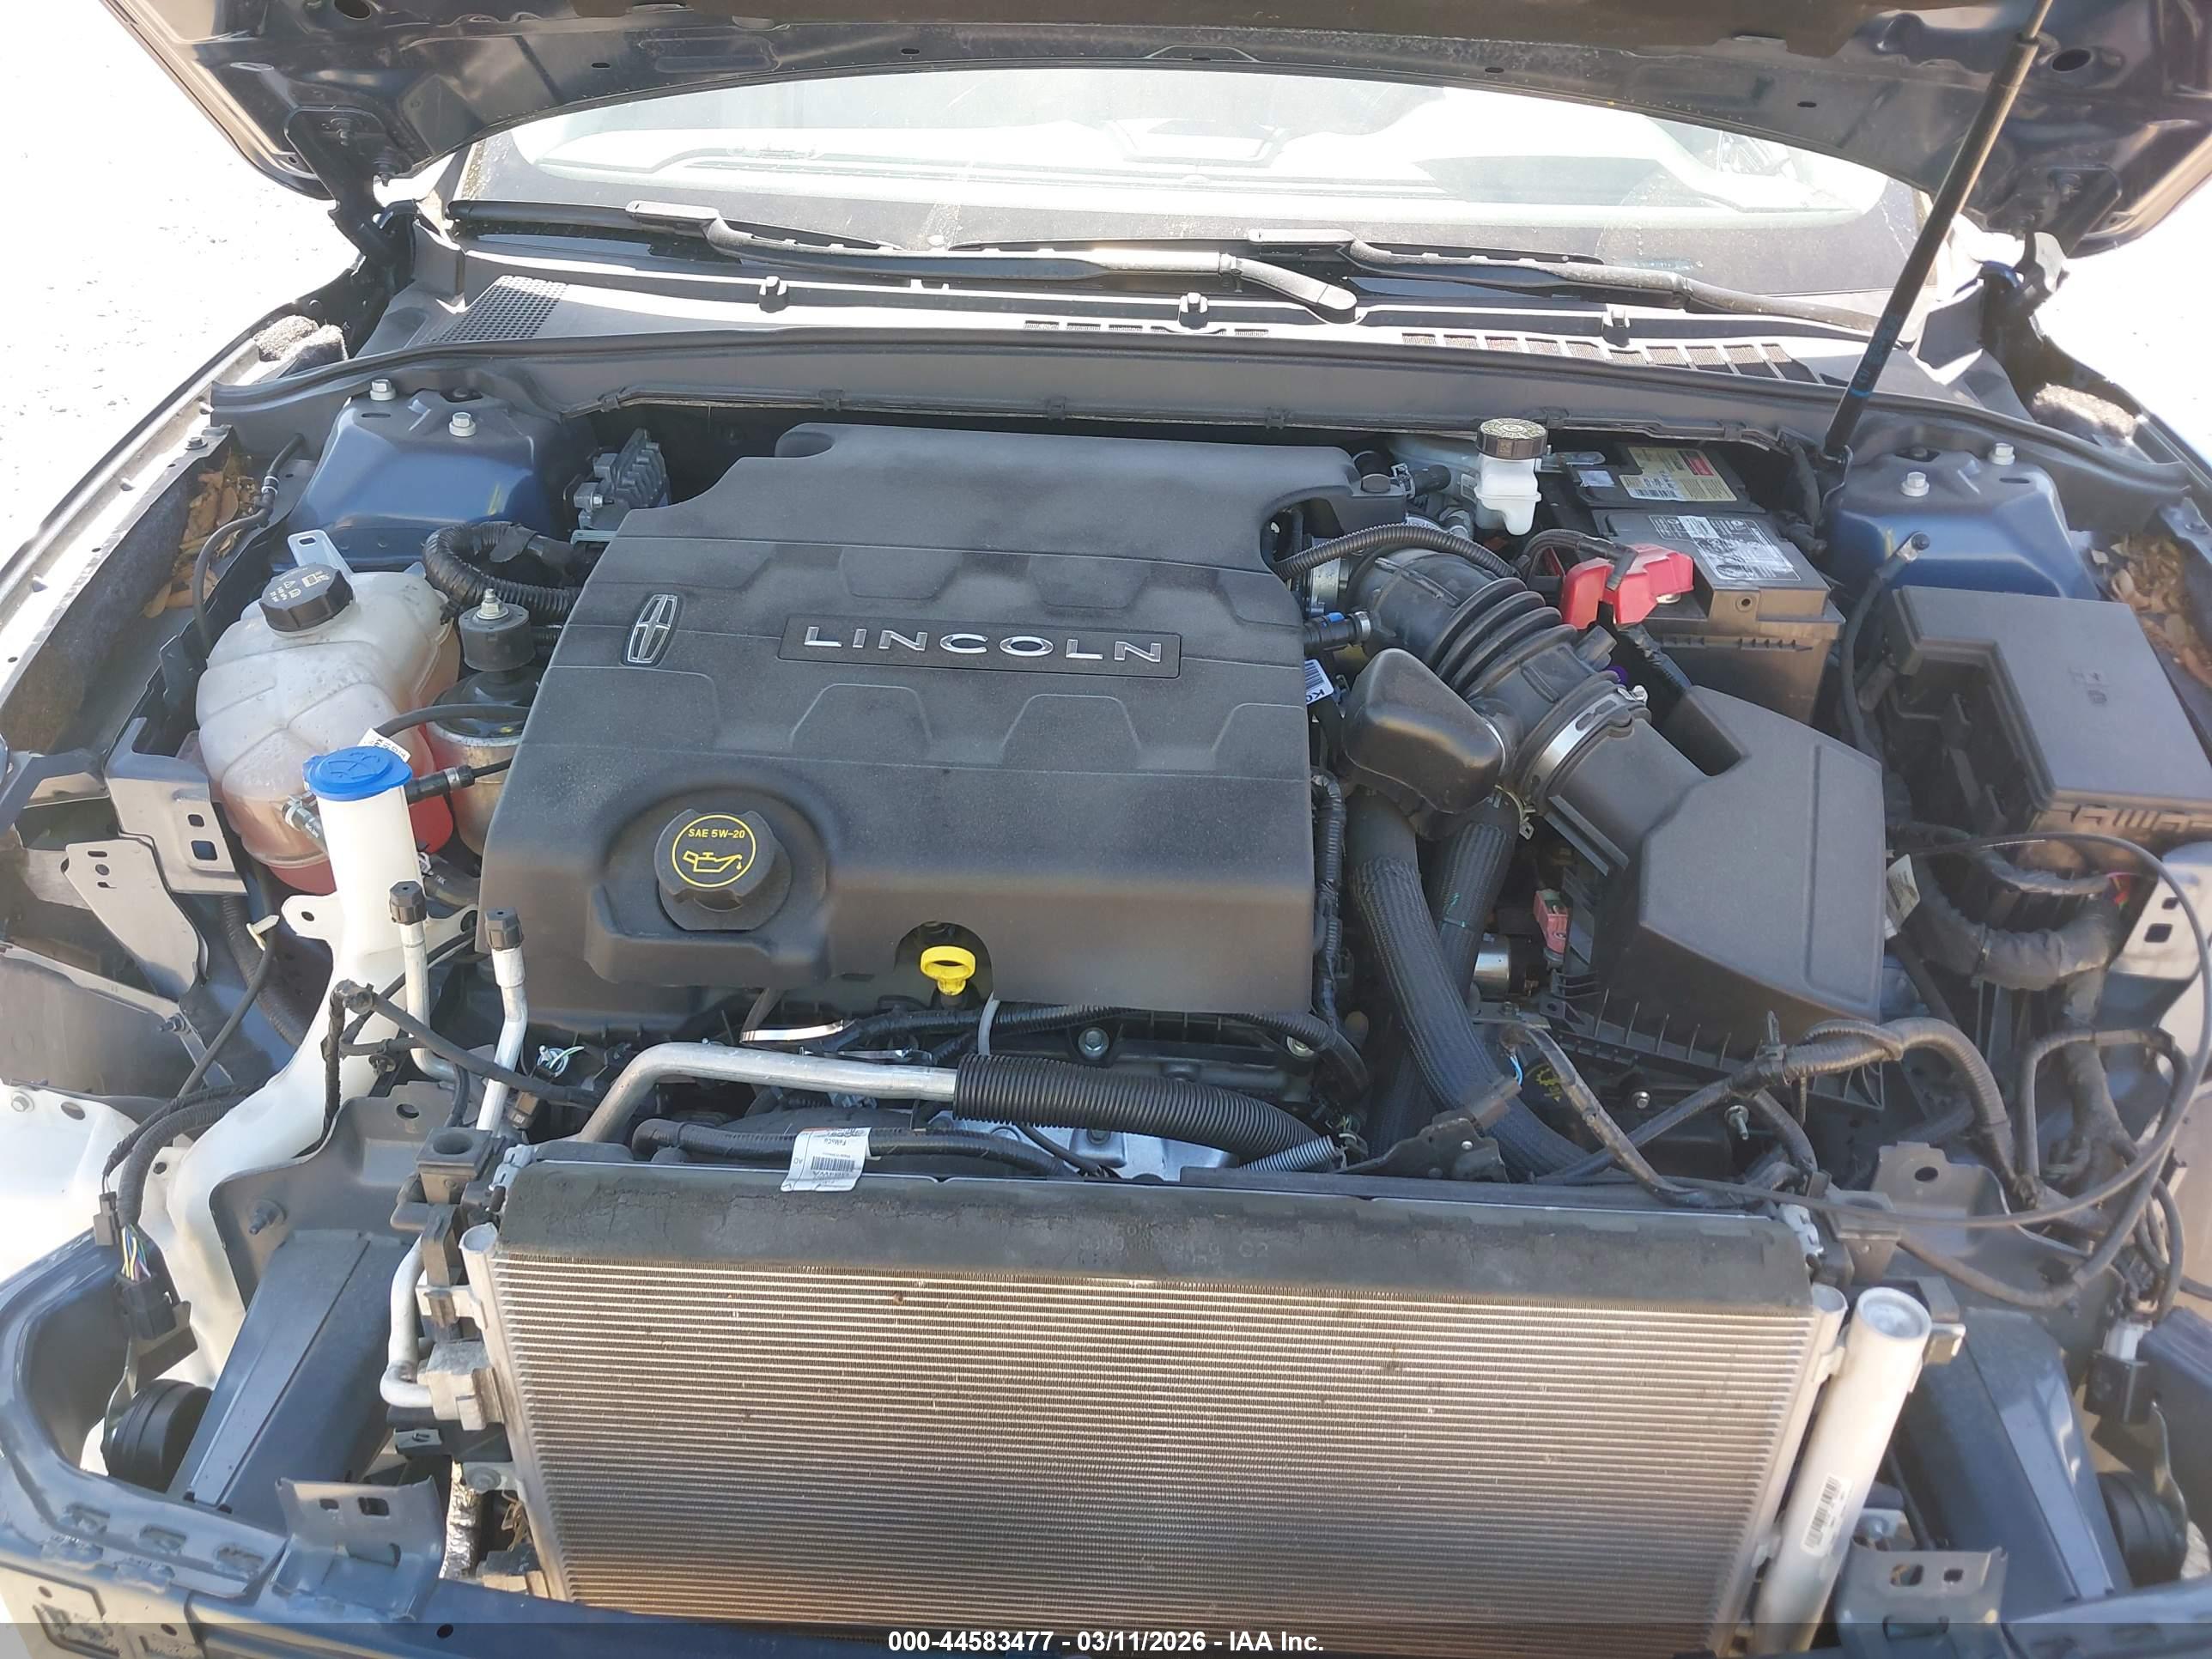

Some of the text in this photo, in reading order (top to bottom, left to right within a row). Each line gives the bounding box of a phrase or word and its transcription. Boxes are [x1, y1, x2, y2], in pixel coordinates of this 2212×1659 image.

[804, 626, 1163, 663] LINCOLN
[688, 828, 745, 839] SAE 5W-20
